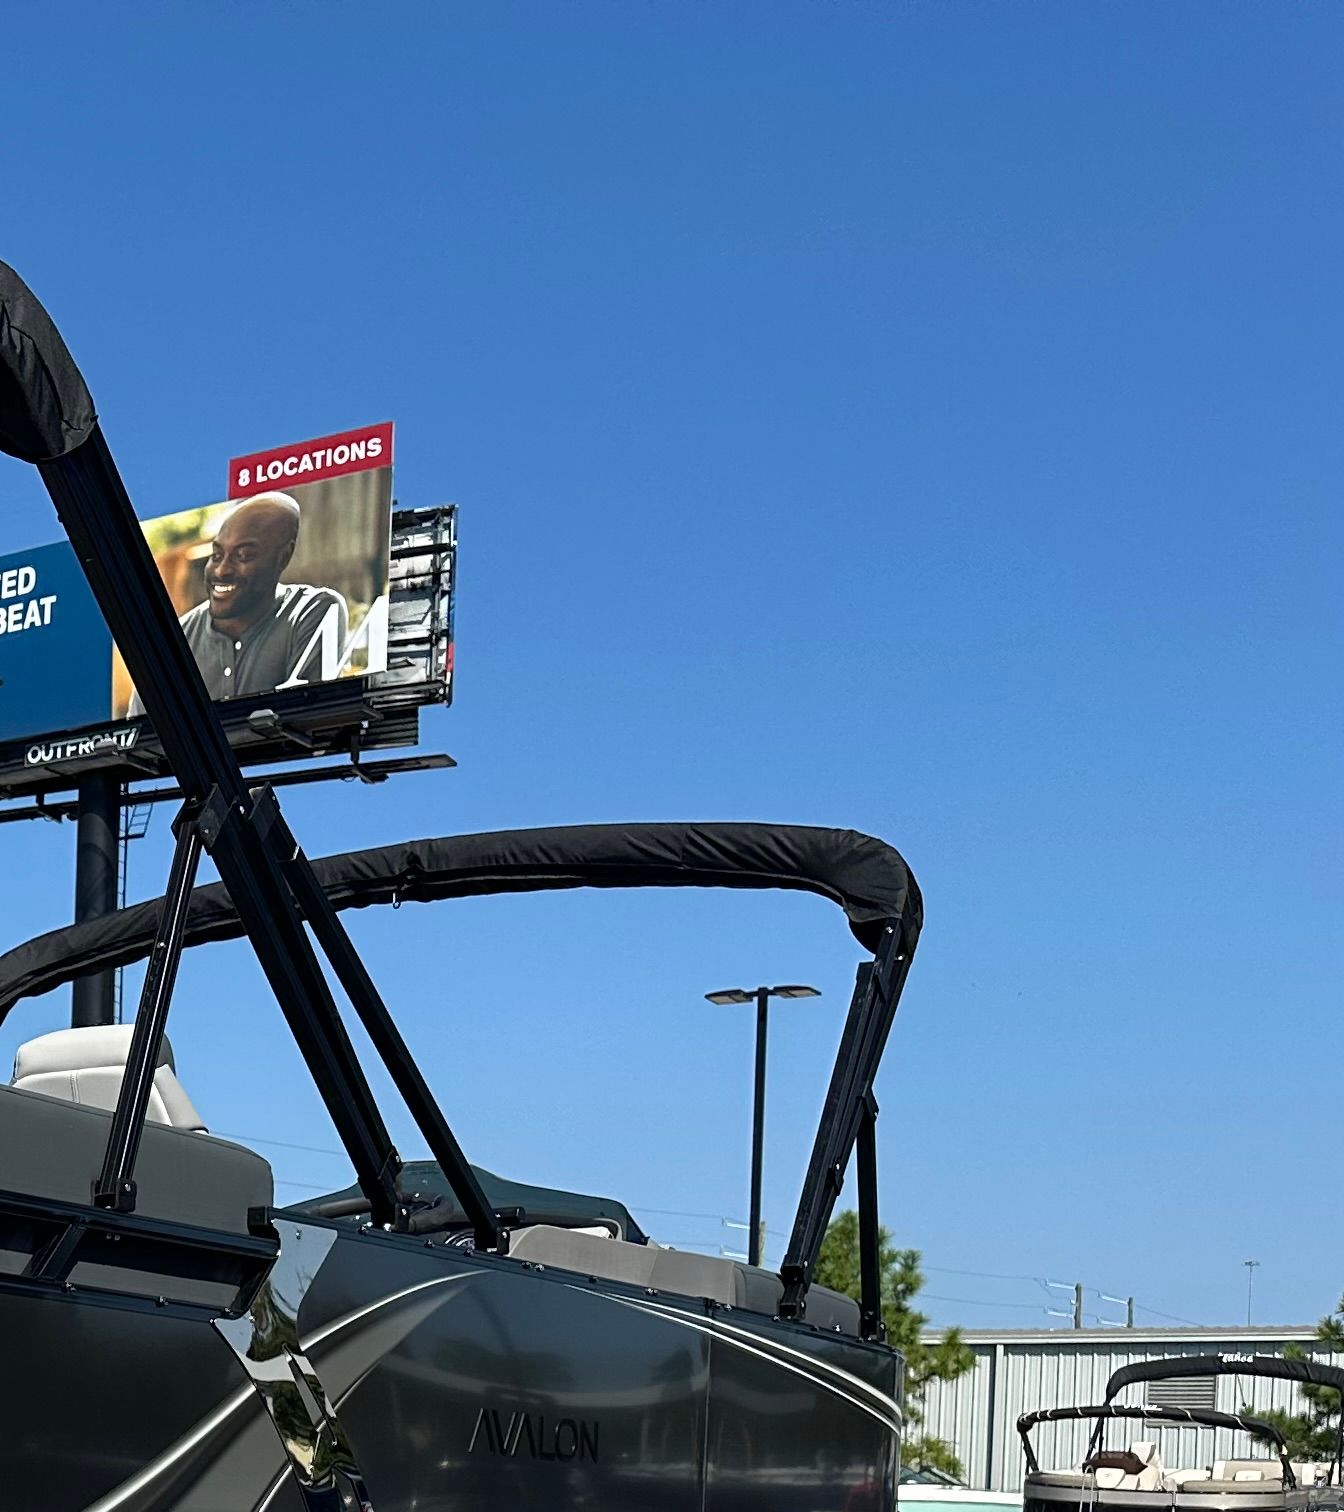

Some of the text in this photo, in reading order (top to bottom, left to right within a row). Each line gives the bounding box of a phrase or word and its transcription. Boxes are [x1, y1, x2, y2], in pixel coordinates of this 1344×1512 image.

[237, 437, 383, 488] 8 LOCATIONS
[468, 1407, 600, 1464] AVALON
